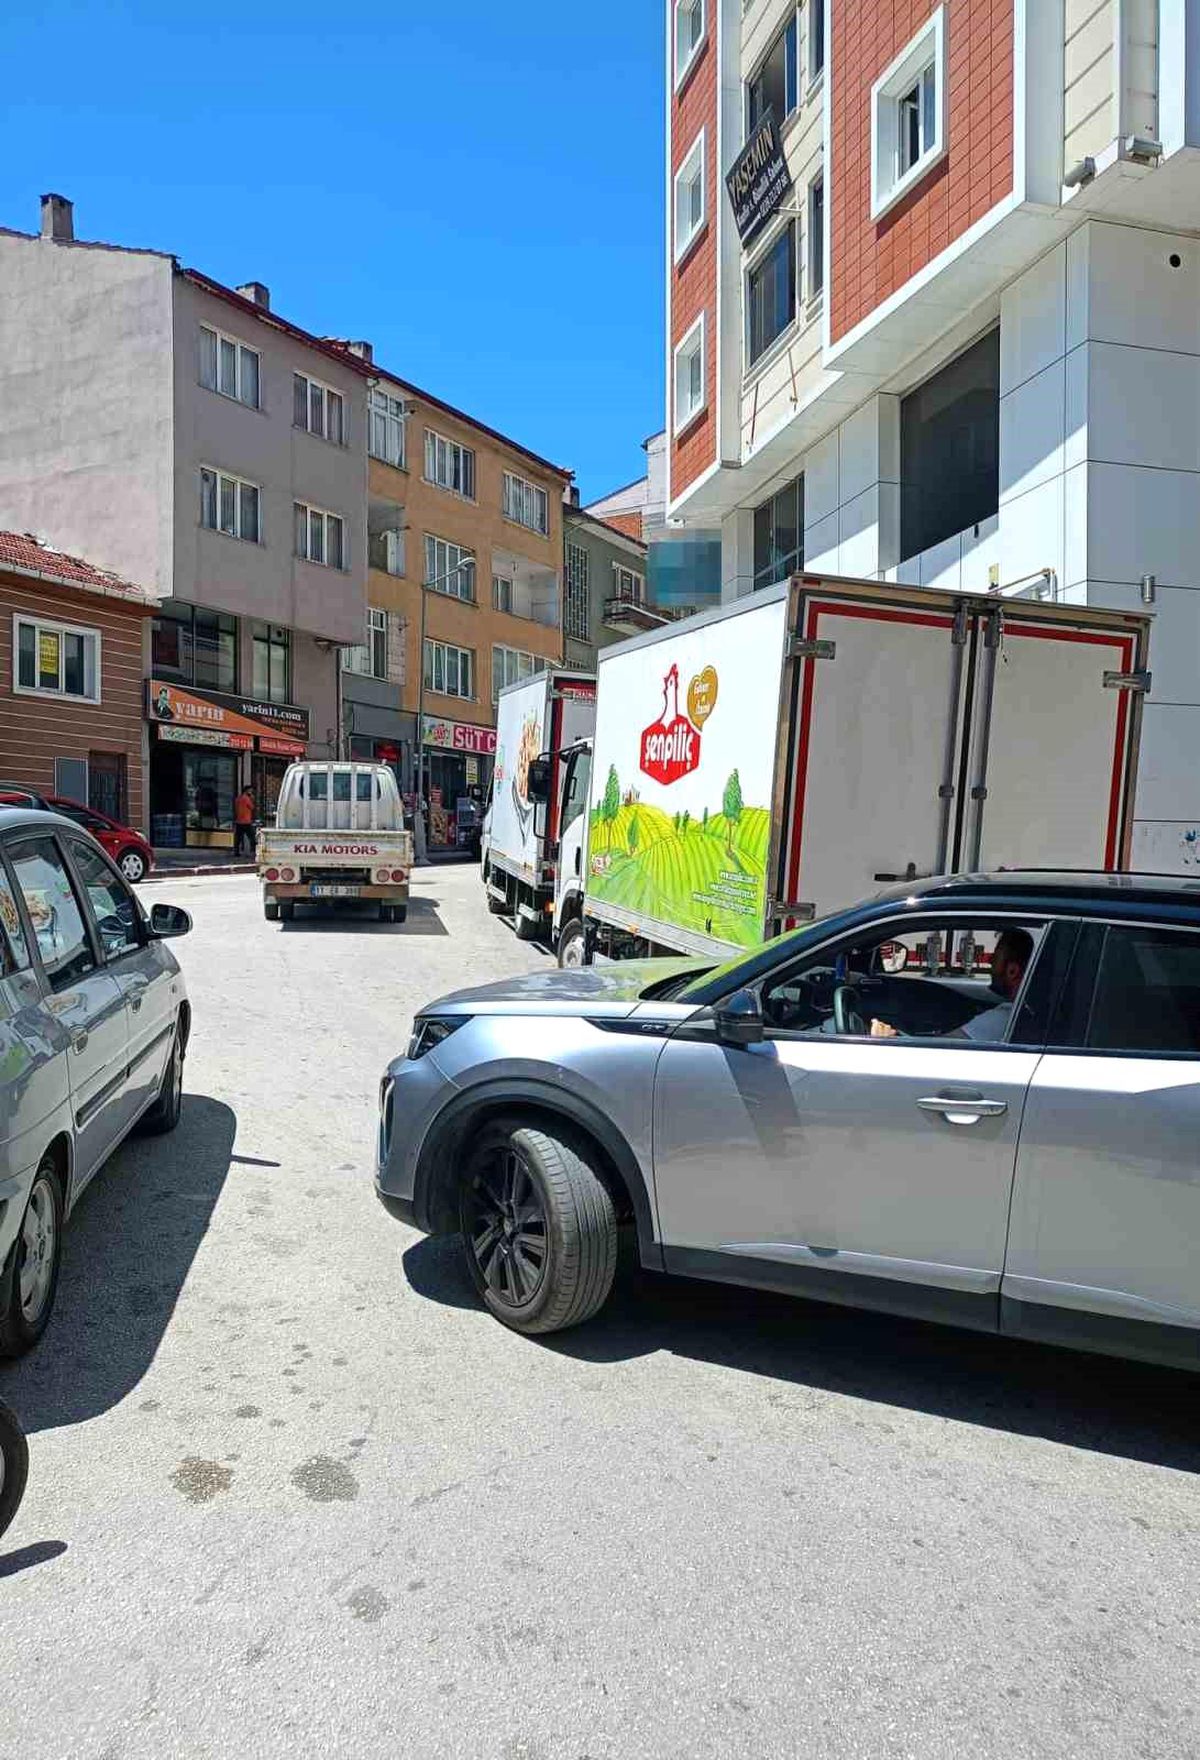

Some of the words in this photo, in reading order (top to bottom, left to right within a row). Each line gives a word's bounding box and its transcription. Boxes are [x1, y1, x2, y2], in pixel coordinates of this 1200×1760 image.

[455, 726, 483, 751] SÜT
[294, 844, 317, 854] KIA
[321, 844, 379, 855] MOTORS
